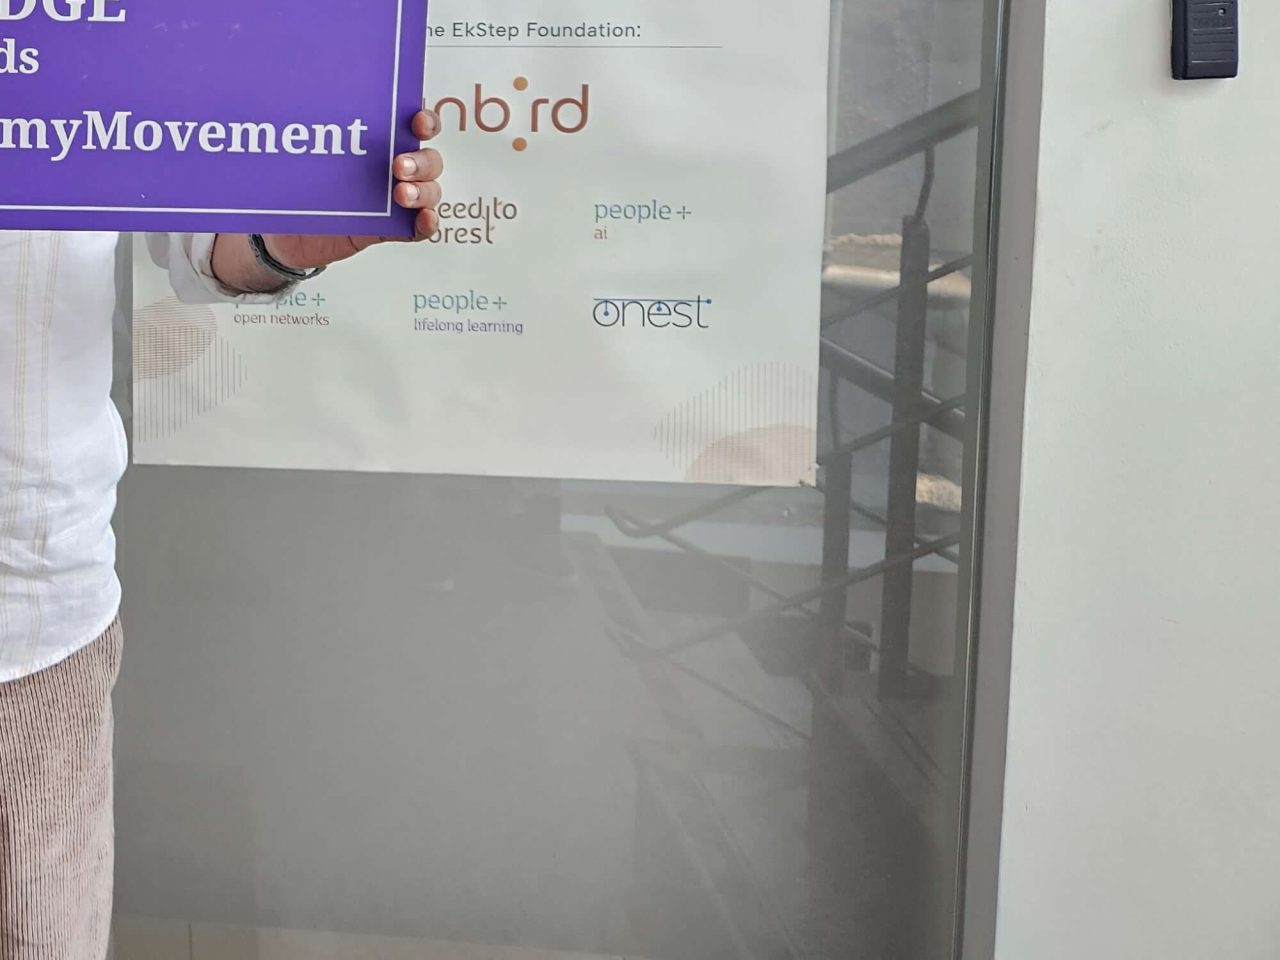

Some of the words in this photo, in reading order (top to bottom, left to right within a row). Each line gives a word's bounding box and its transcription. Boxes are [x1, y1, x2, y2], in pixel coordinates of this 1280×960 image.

[452, 22, 520, 40] EkStep
[527, 22, 641, 38] Foundation:
[437, 197, 483, 219] eed
[493, 197, 518, 220] to
[593, 226, 608, 240] ai
[233, 313, 267, 326] open
[270, 313, 330, 326] networks
[592, 295, 712, 329] onest
[414, 318, 464, 334] lifelong
[467, 319, 524, 336] learning
